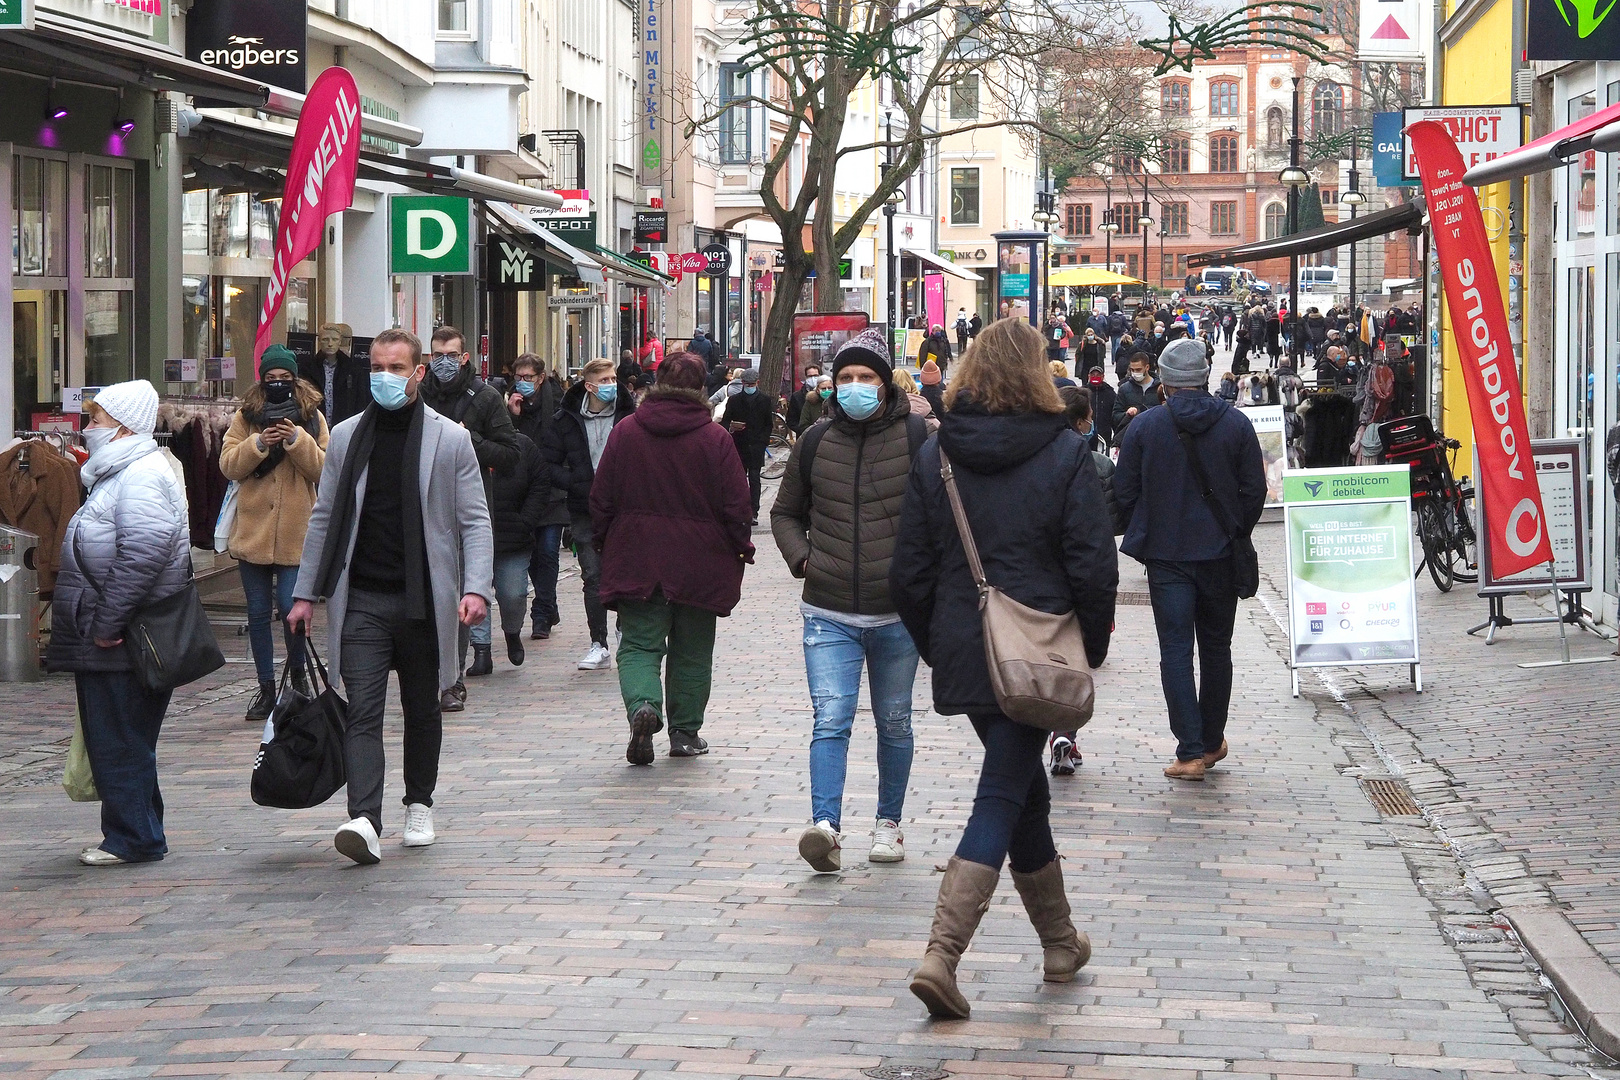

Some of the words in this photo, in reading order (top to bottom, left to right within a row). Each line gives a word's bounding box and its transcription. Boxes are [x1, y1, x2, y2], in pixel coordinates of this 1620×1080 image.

[200, 44, 299, 69] engbers
[645, 50, 659, 130] Markt
[1461, 116, 1501, 142] HCT
[537, 220, 592, 230] DEPOT
[406, 209, 458, 259] D
[683, 256, 701, 268] Viba
[549, 297, 599, 305] Buchbinderstraße
[1332, 476, 1389, 487] mobilcom
[1332, 487, 1366, 497] debitel
[1326, 521, 1339, 530] DU
[1309, 535, 1334, 545] DEIN
[1336, 532, 1389, 544] INTERNET
[1310, 545, 1331, 557] FÜR
[1333, 544, 1384, 556] ZUHAUSE
[1311, 622, 1323, 630] 1&1
[1365, 618, 1400, 627] CHECK24
